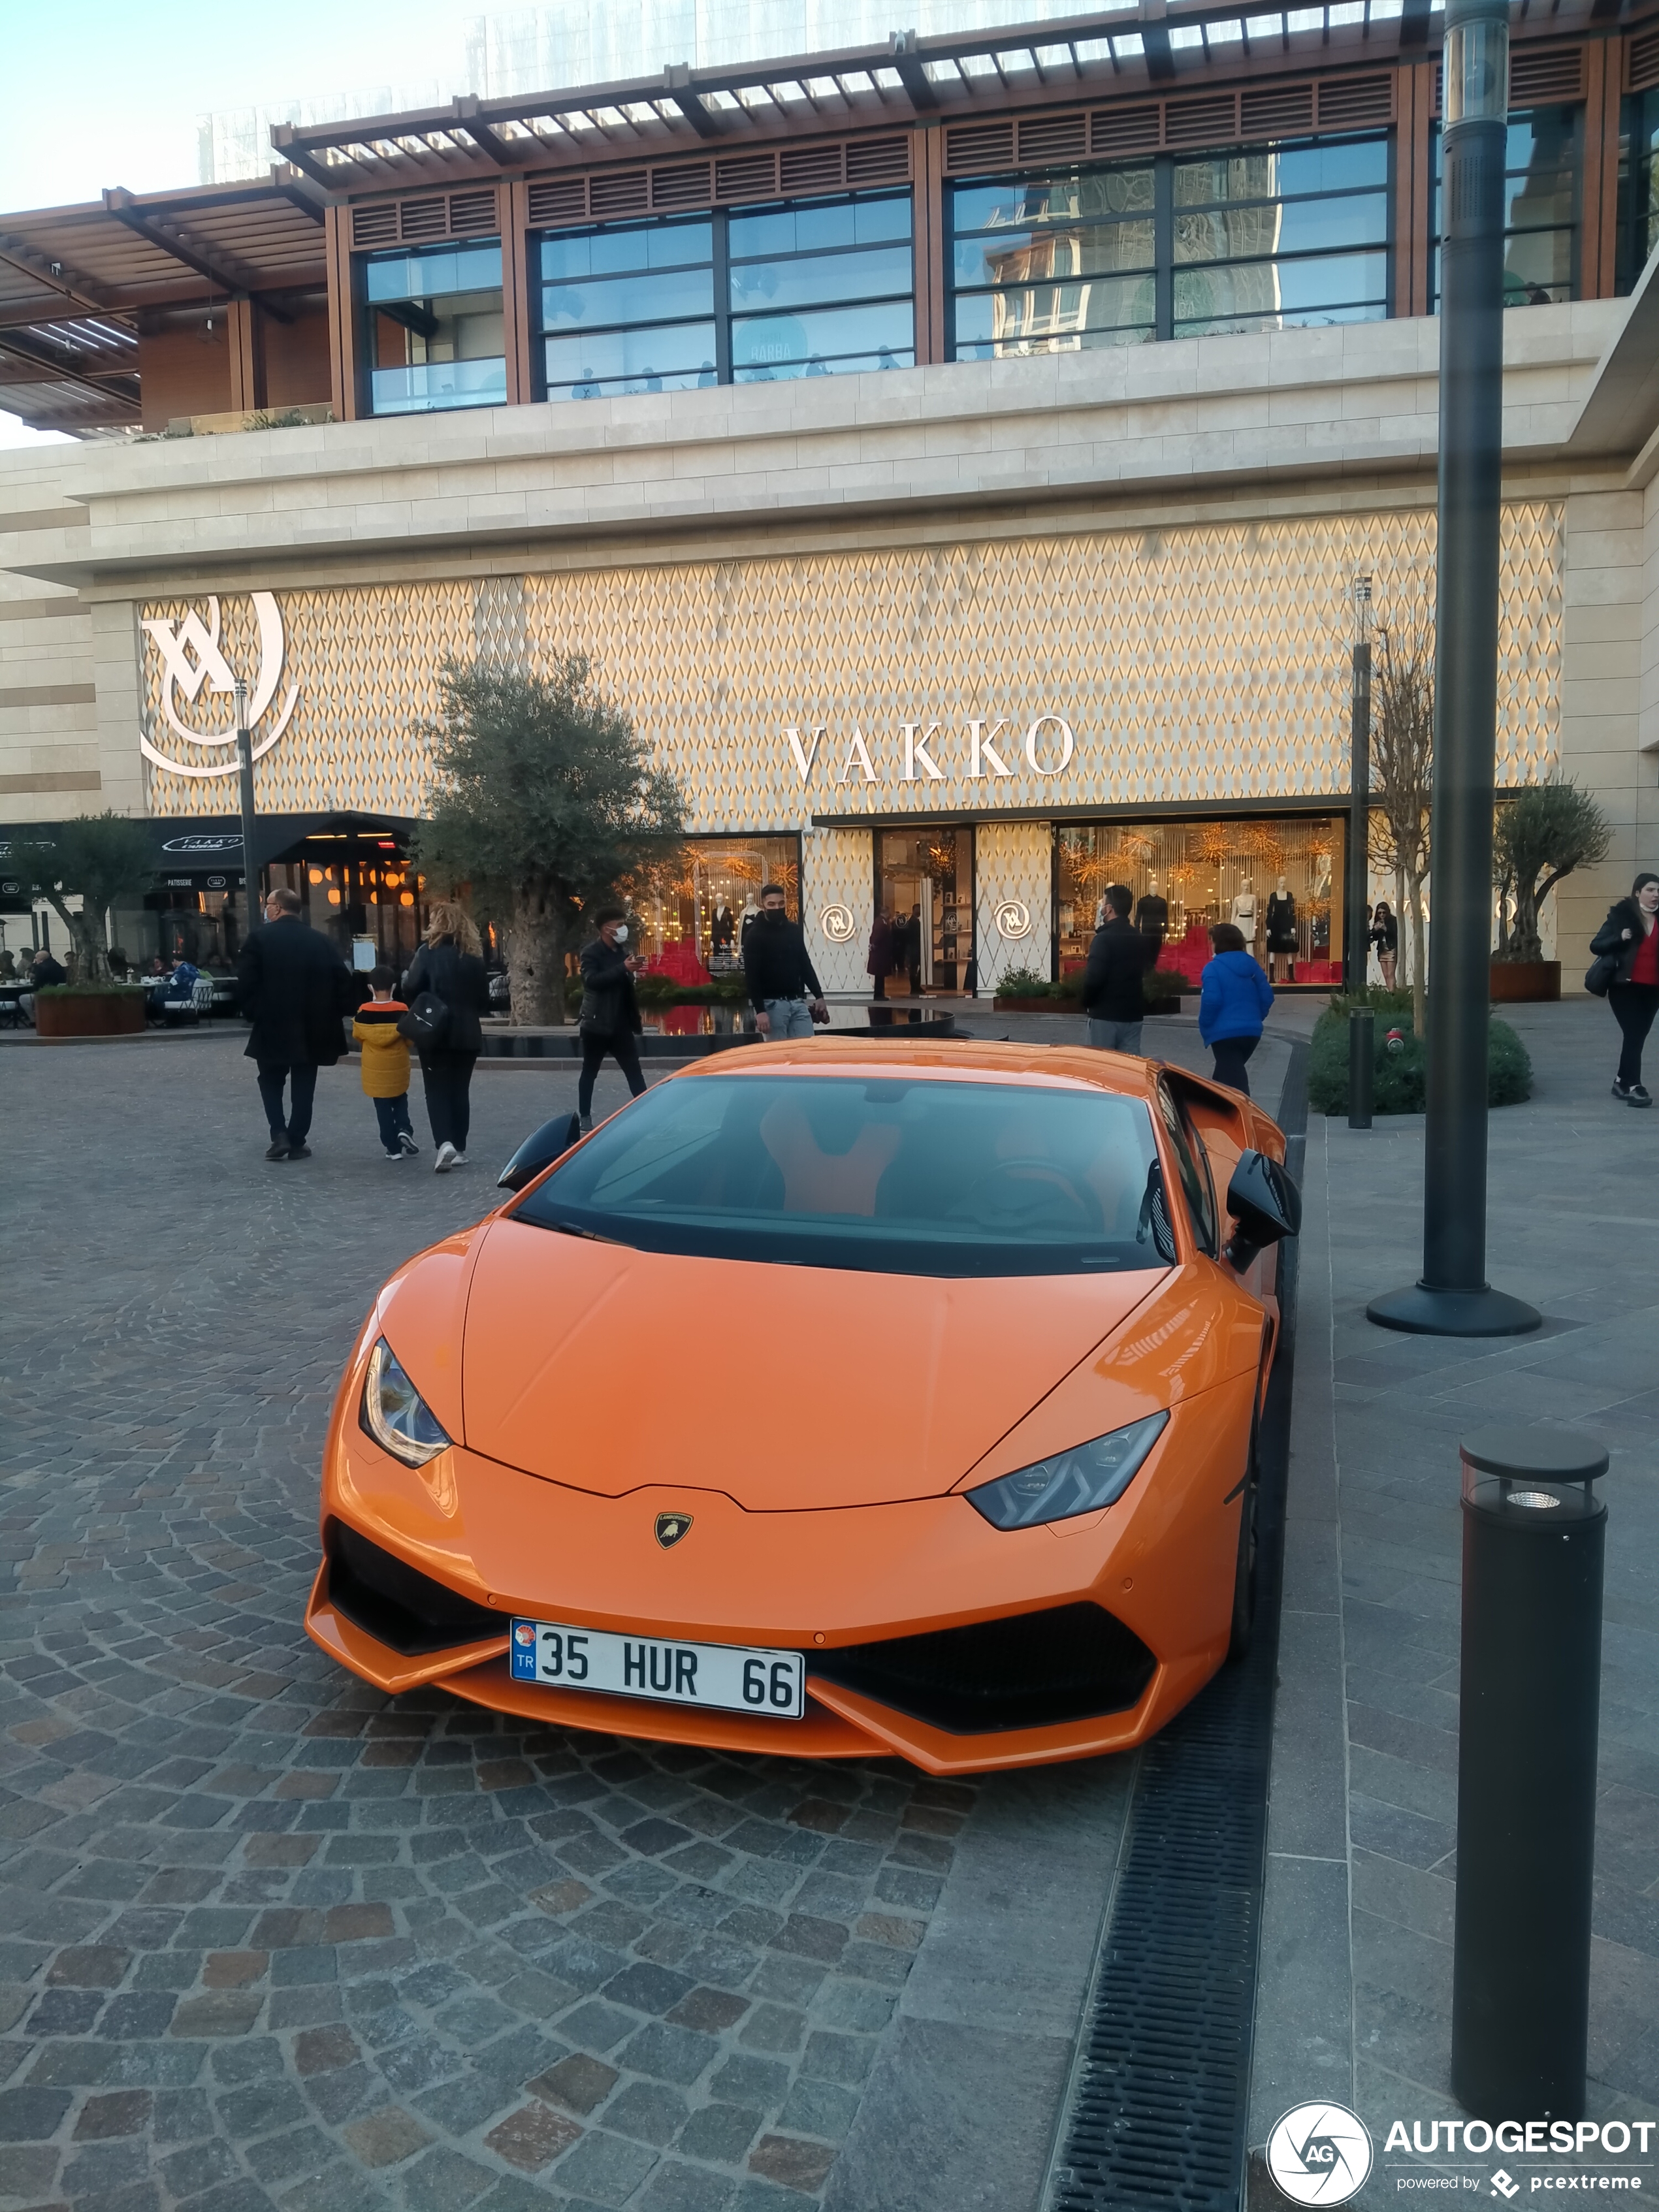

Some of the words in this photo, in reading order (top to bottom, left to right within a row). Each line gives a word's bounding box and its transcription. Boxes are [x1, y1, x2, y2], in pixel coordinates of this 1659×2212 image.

[782, 715, 1075, 784] VAKKO
[660, 1515, 690, 1523] LAMBORGHINI
[517, 1654, 534, 1669] TR
[541, 1631, 589, 1680] 35
[624, 1643, 698, 1696] HUR
[743, 1659, 794, 1708] 66
